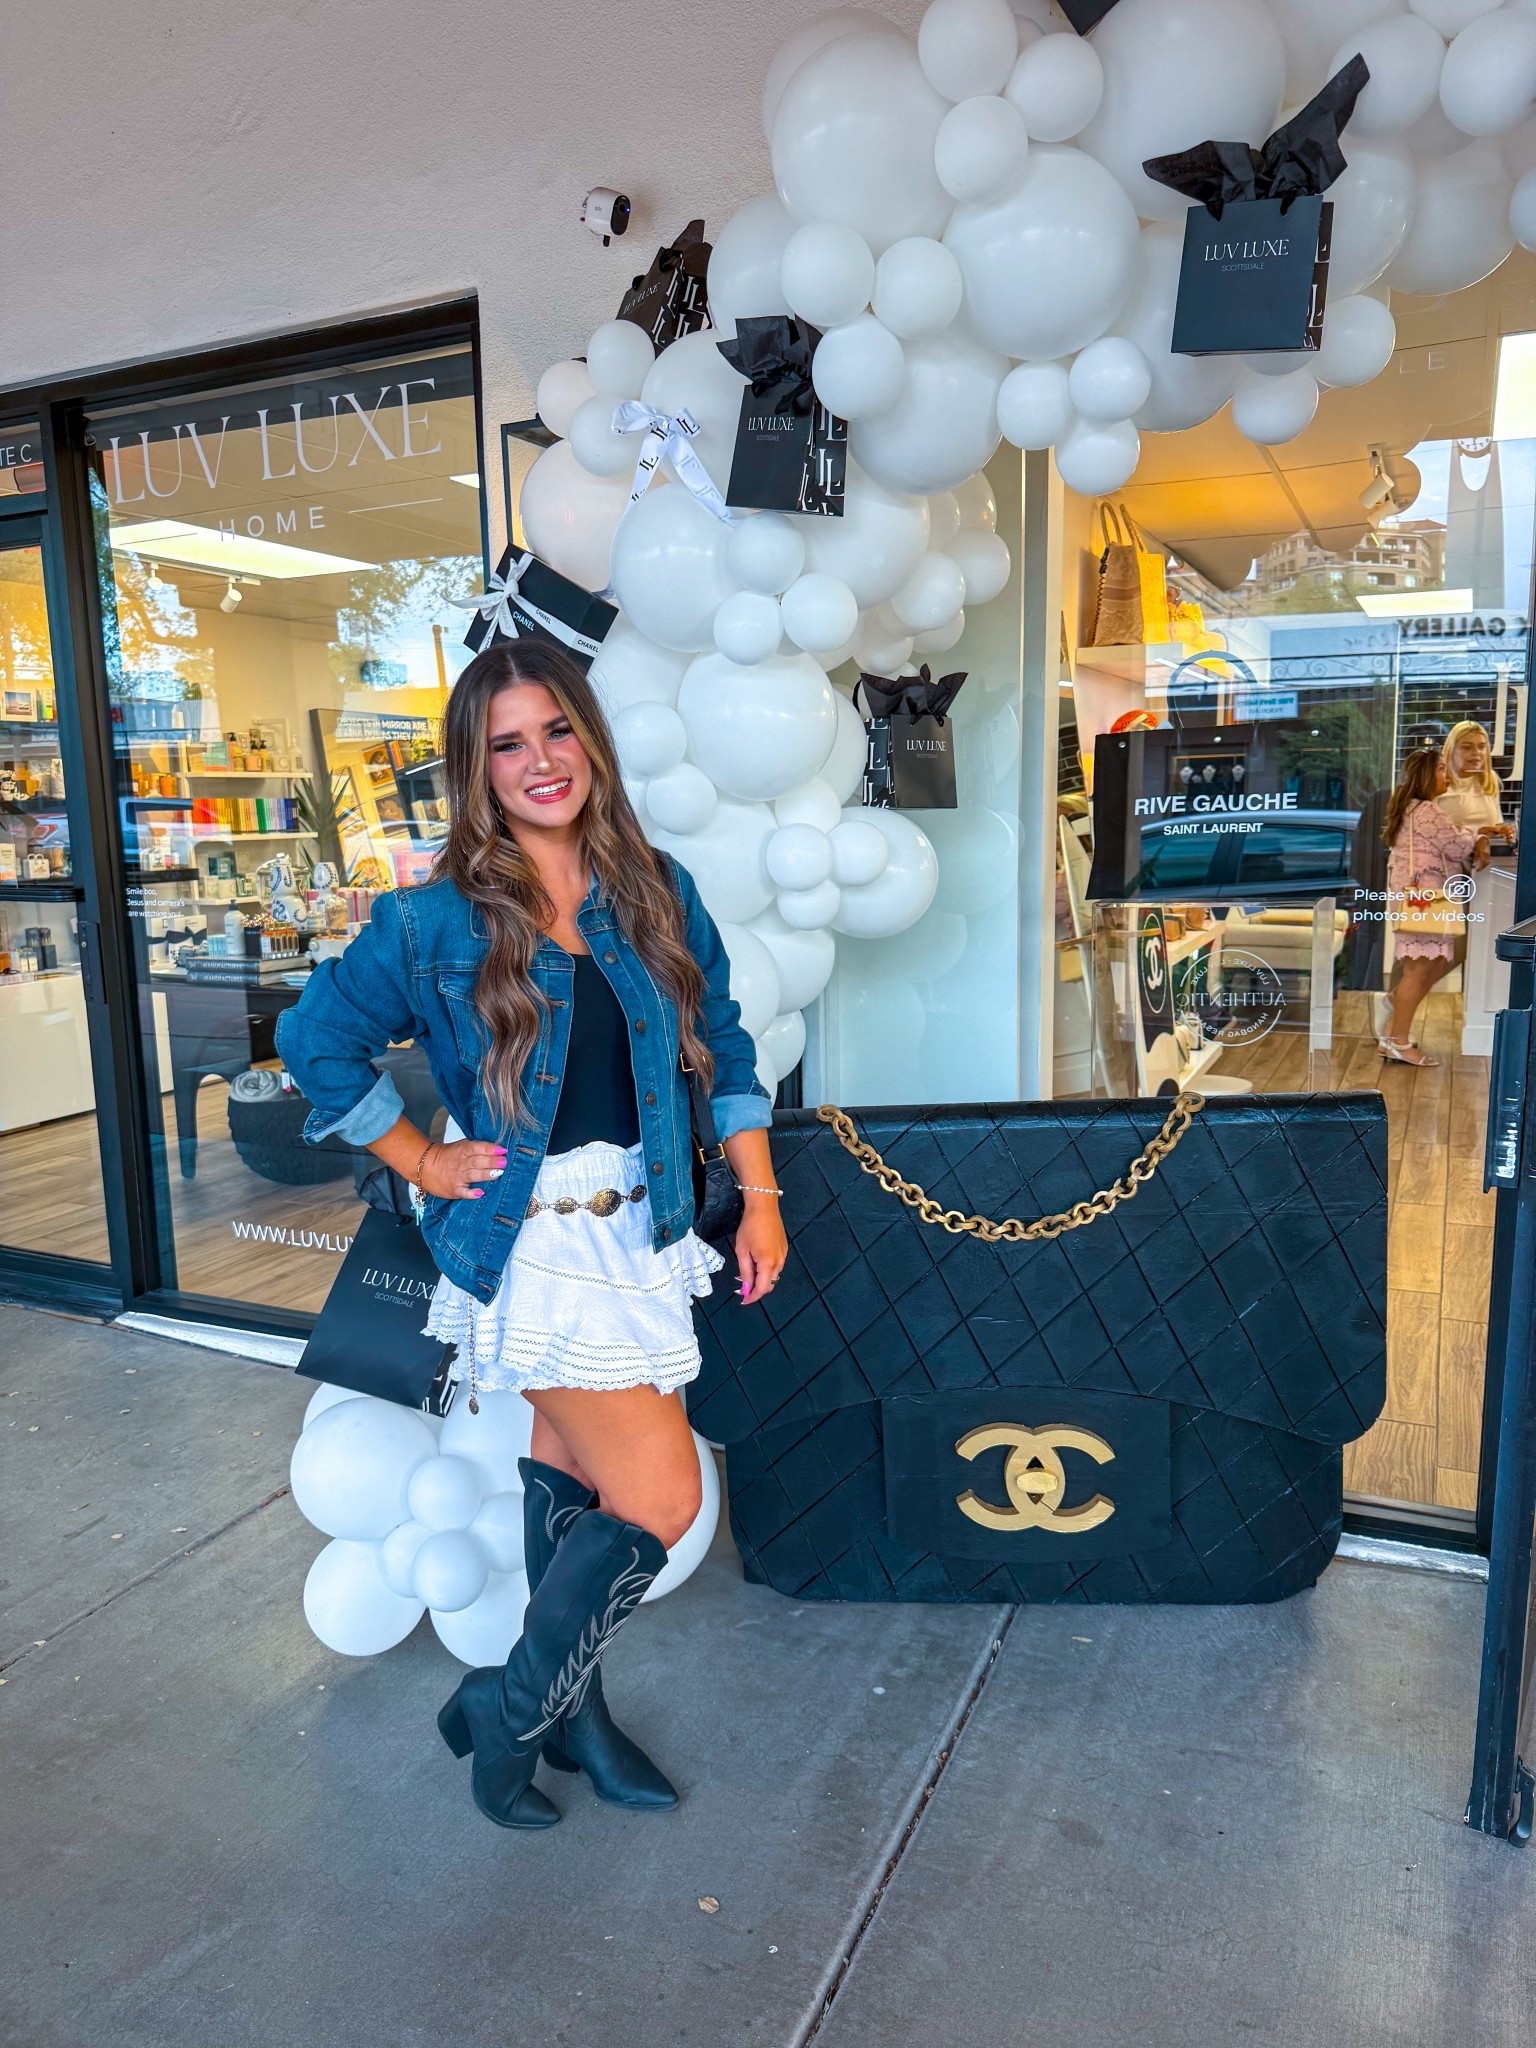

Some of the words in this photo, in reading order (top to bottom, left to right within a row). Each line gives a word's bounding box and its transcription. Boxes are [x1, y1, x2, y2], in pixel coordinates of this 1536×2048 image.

[1204, 242, 1239, 261] LUV
[1243, 238, 1289, 258] LUXE
[1221, 262, 1265, 272] SCOTTSDALE
[748, 417, 768, 431] LUV
[768, 417, 795, 431] LUXE
[109, 415, 231, 504] LUV
[257, 378, 442, 481] LUXE
[218, 506, 326, 541] HOME
[512, 610, 535, 632] CHANEL
[535, 609, 551, 625] CHANEL
[577, 639, 600, 653] CHANEL
[382, 720, 411, 729] MIRROR
[413, 721, 427, 731] ARE
[392, 732, 411, 740] THEY
[906, 740, 926, 751] LUV
[927, 740, 947, 752] LUXE
[1134, 796, 1187, 816] RIVE
[1192, 792, 1298, 813] GAUCHE
[1163, 824, 1199, 836] SAINT
[1202, 822, 1263, 834] LAURENT
[1354, 889, 1405, 901] Please
[1409, 889, 1436, 901] NO
[158, 899, 185, 907] camera's
[1353, 909, 1408, 923] photos
[1412, 911, 1428, 921] or
[1432, 909, 1485, 922] videos
[362, 1268, 397, 1289] LUV
[375, 1291, 415, 1308] SCOTTSDALE
